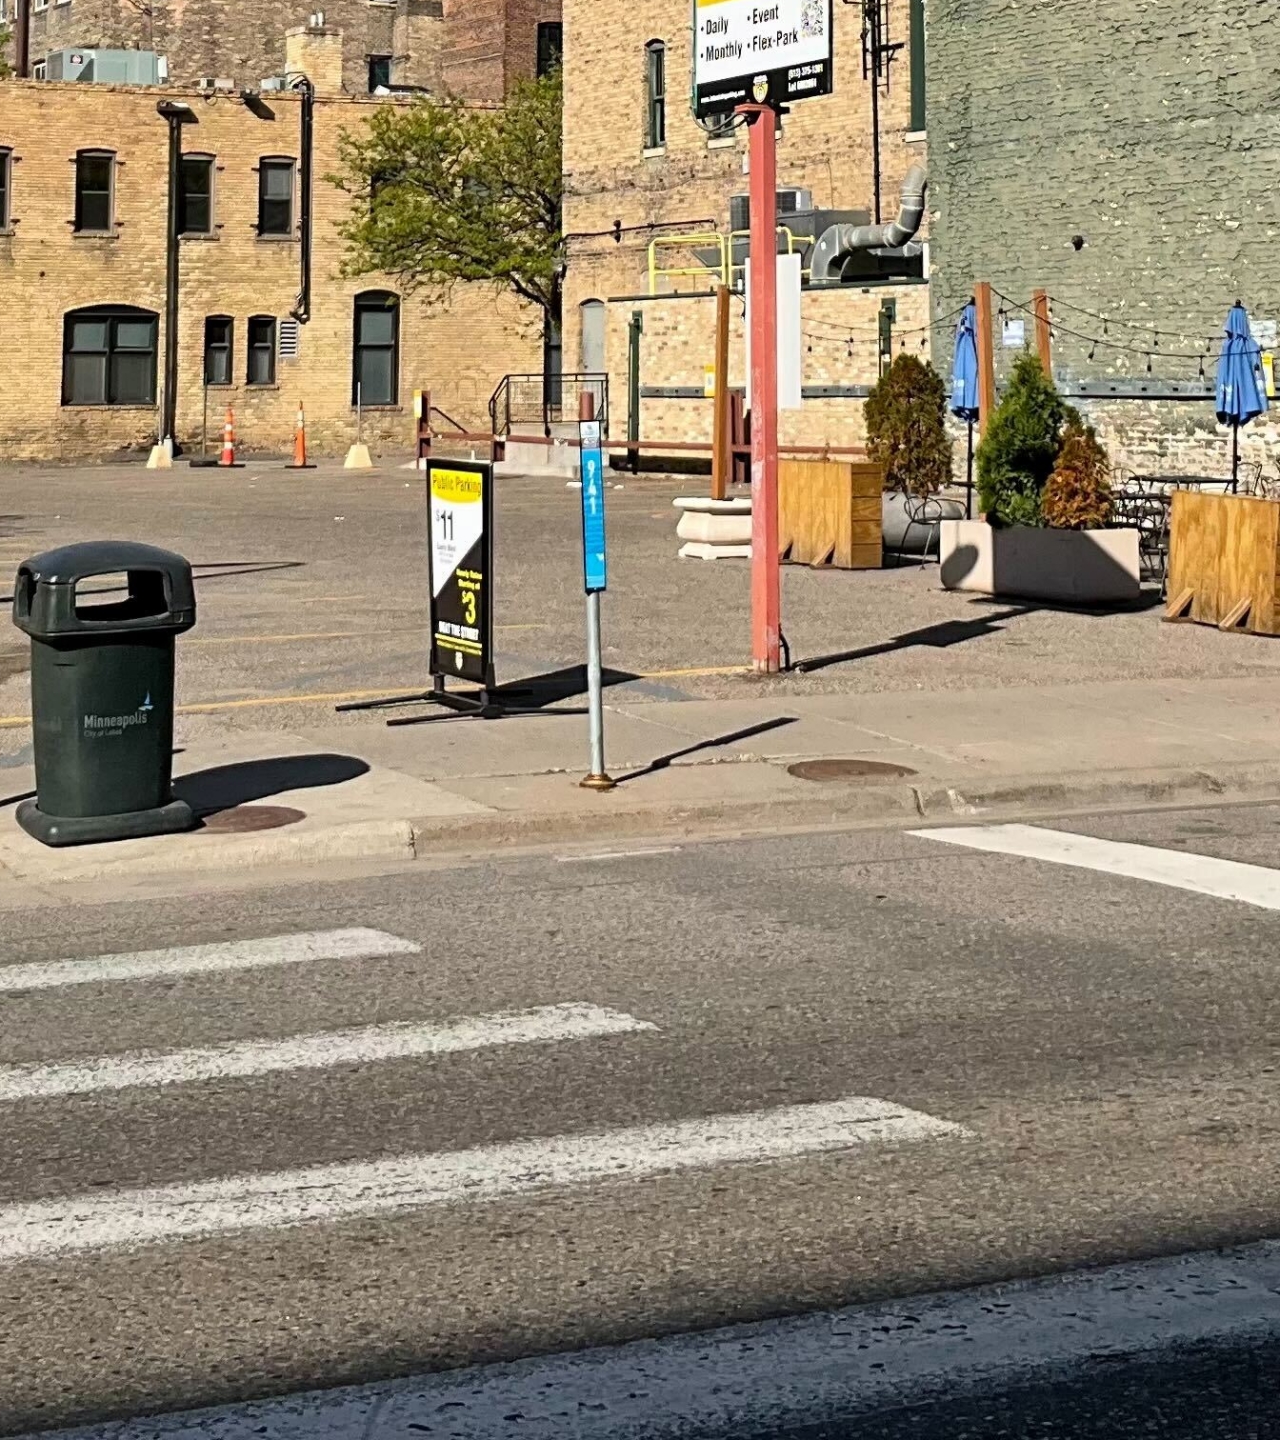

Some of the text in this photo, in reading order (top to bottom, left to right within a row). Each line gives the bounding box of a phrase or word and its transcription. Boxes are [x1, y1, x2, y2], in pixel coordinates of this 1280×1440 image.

[706, 4, 779, 36] Daily Event
[706, 29, 799, 63] Monthly Flex-Park
[432, 474, 482, 498] Public Parking
[84, 711, 148, 729] Minneapolis
[83, 729, 96, 739] City
